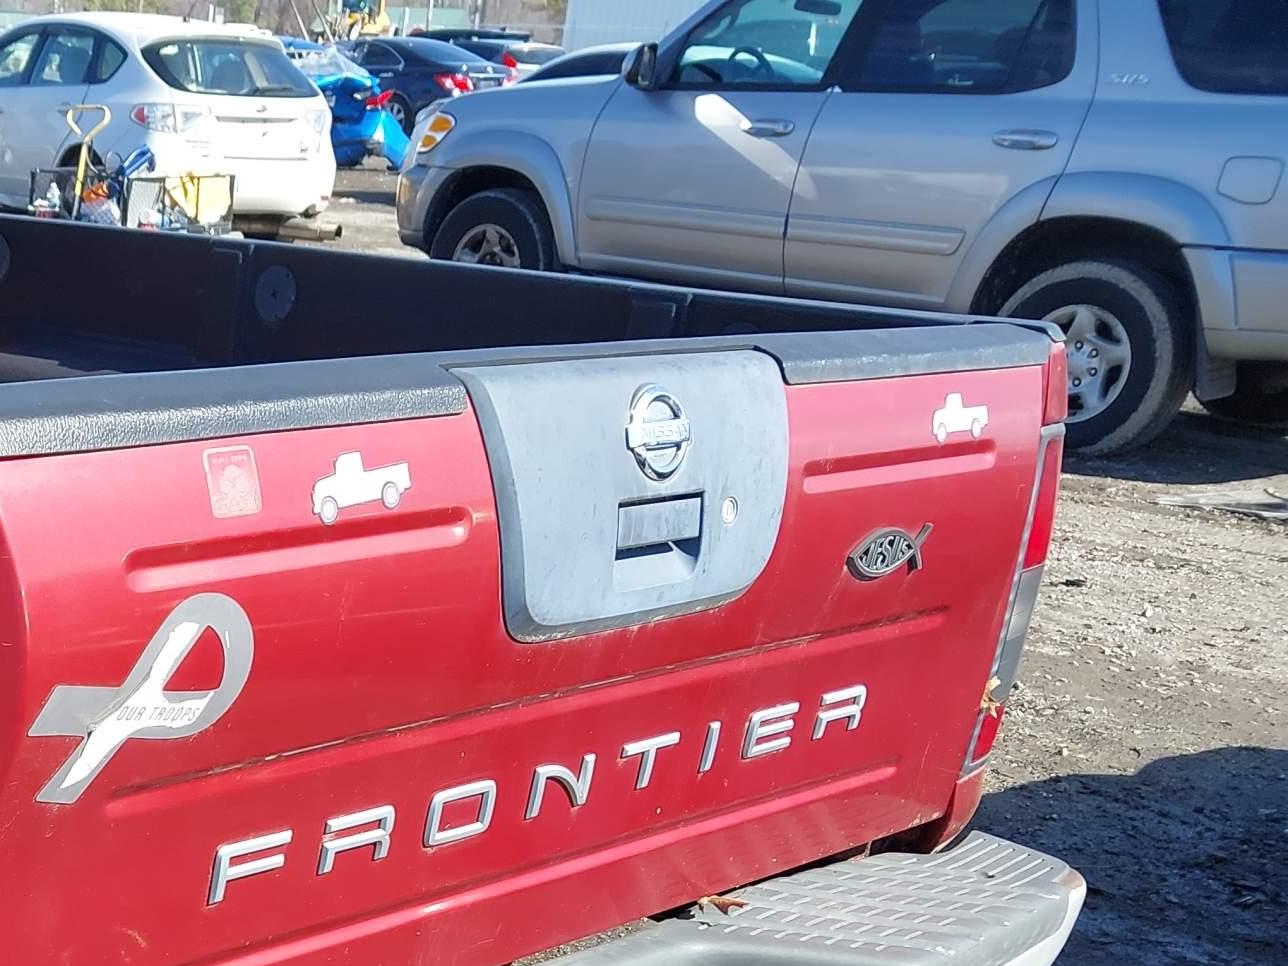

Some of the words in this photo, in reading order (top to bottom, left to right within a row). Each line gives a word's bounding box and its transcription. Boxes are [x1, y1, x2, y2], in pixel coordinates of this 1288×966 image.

[640, 423, 689, 442] NISSAN
[861, 534, 912, 569] JESUS
[117, 705, 146, 721] OUR
[148, 706, 200, 722] TROOPS
[207, 684, 867, 906] FRONTIER
